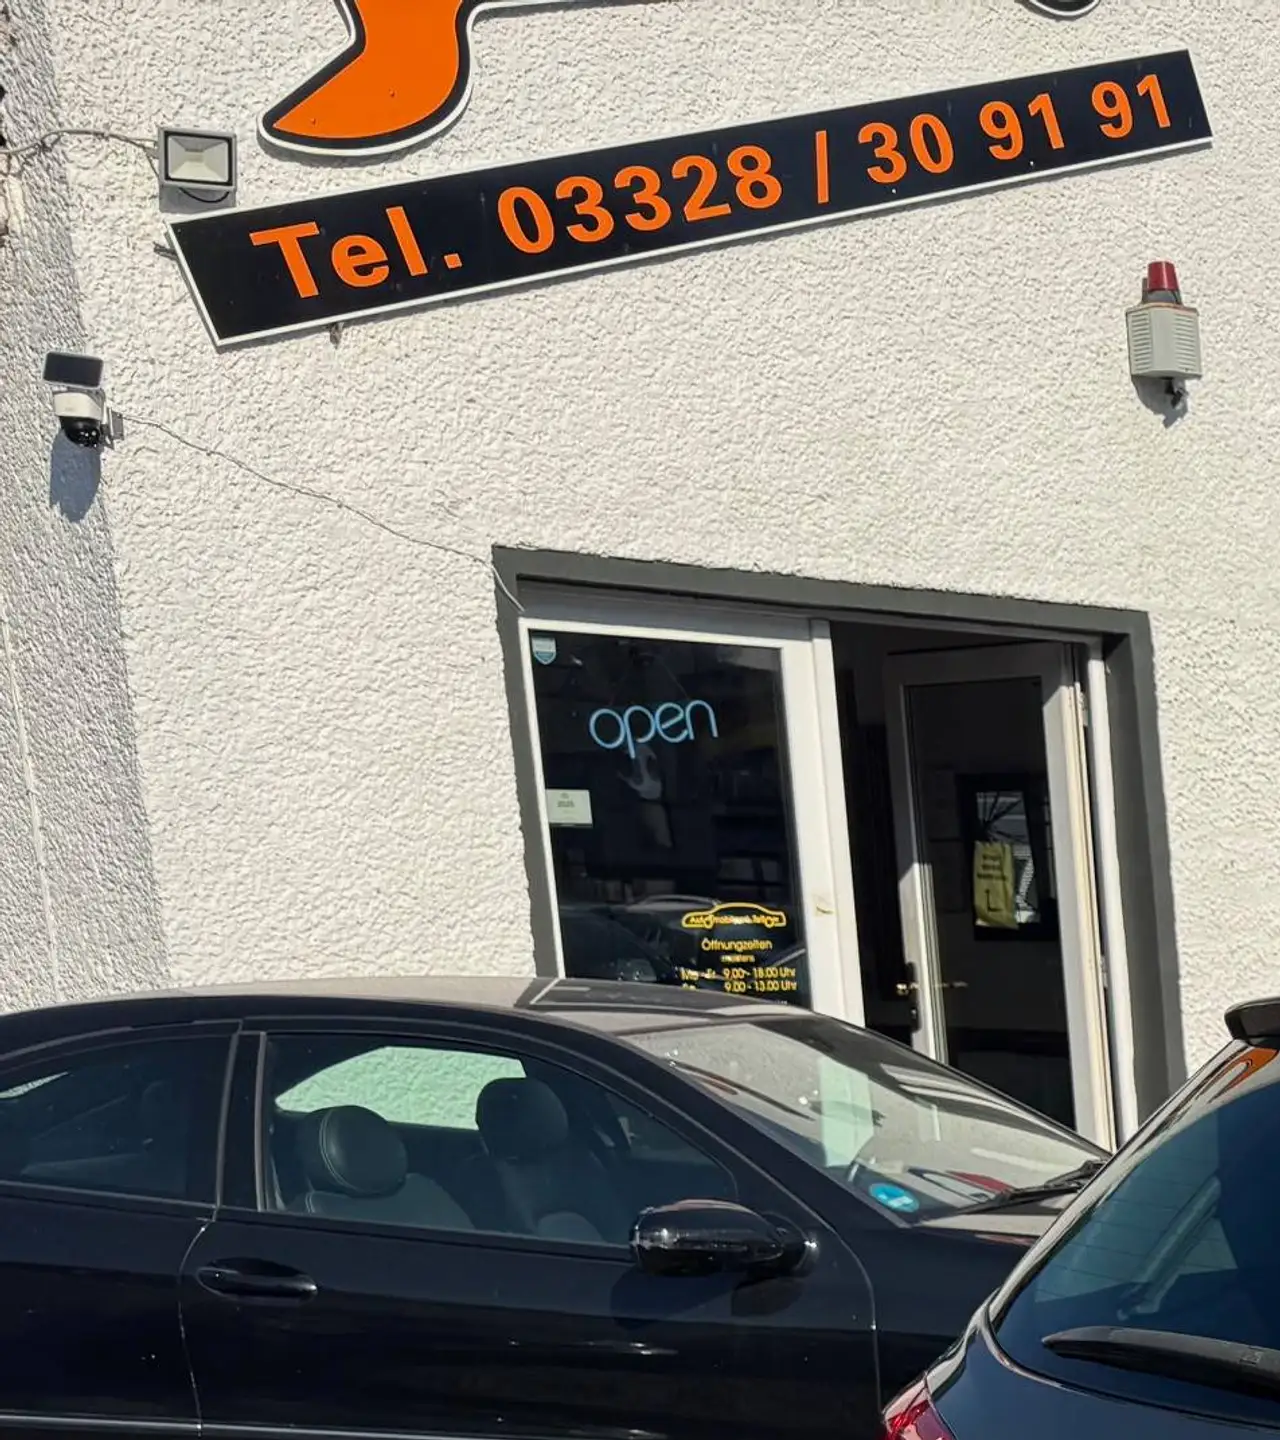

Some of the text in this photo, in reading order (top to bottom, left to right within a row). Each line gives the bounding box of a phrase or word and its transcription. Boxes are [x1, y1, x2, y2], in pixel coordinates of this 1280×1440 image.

[249, 73, 1173, 300] Tel. 03328 / 30 91 91
[588, 699, 719, 759] open
